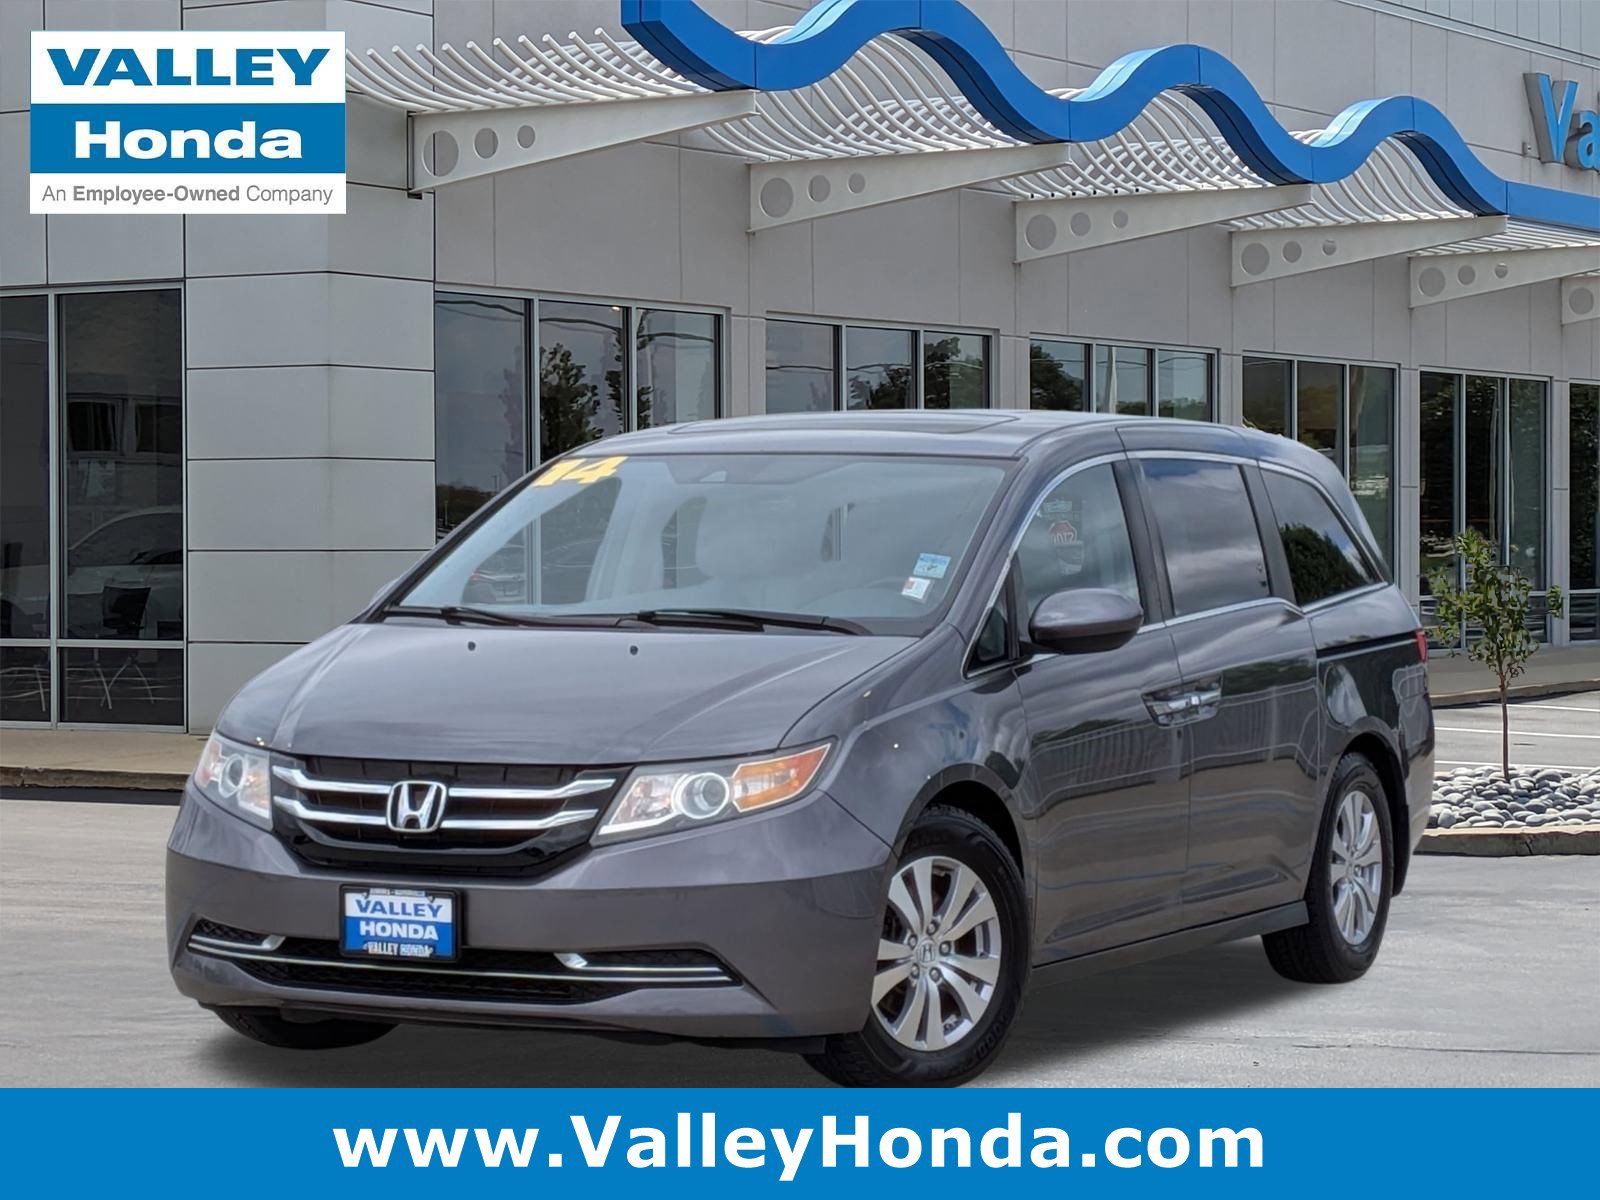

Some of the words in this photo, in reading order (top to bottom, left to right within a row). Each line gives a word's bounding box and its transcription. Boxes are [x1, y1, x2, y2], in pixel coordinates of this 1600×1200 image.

[1522, 72, 1600, 170] Va
[355, 899, 442, 918] VALLEY
[359, 920, 439, 940] HONDA
